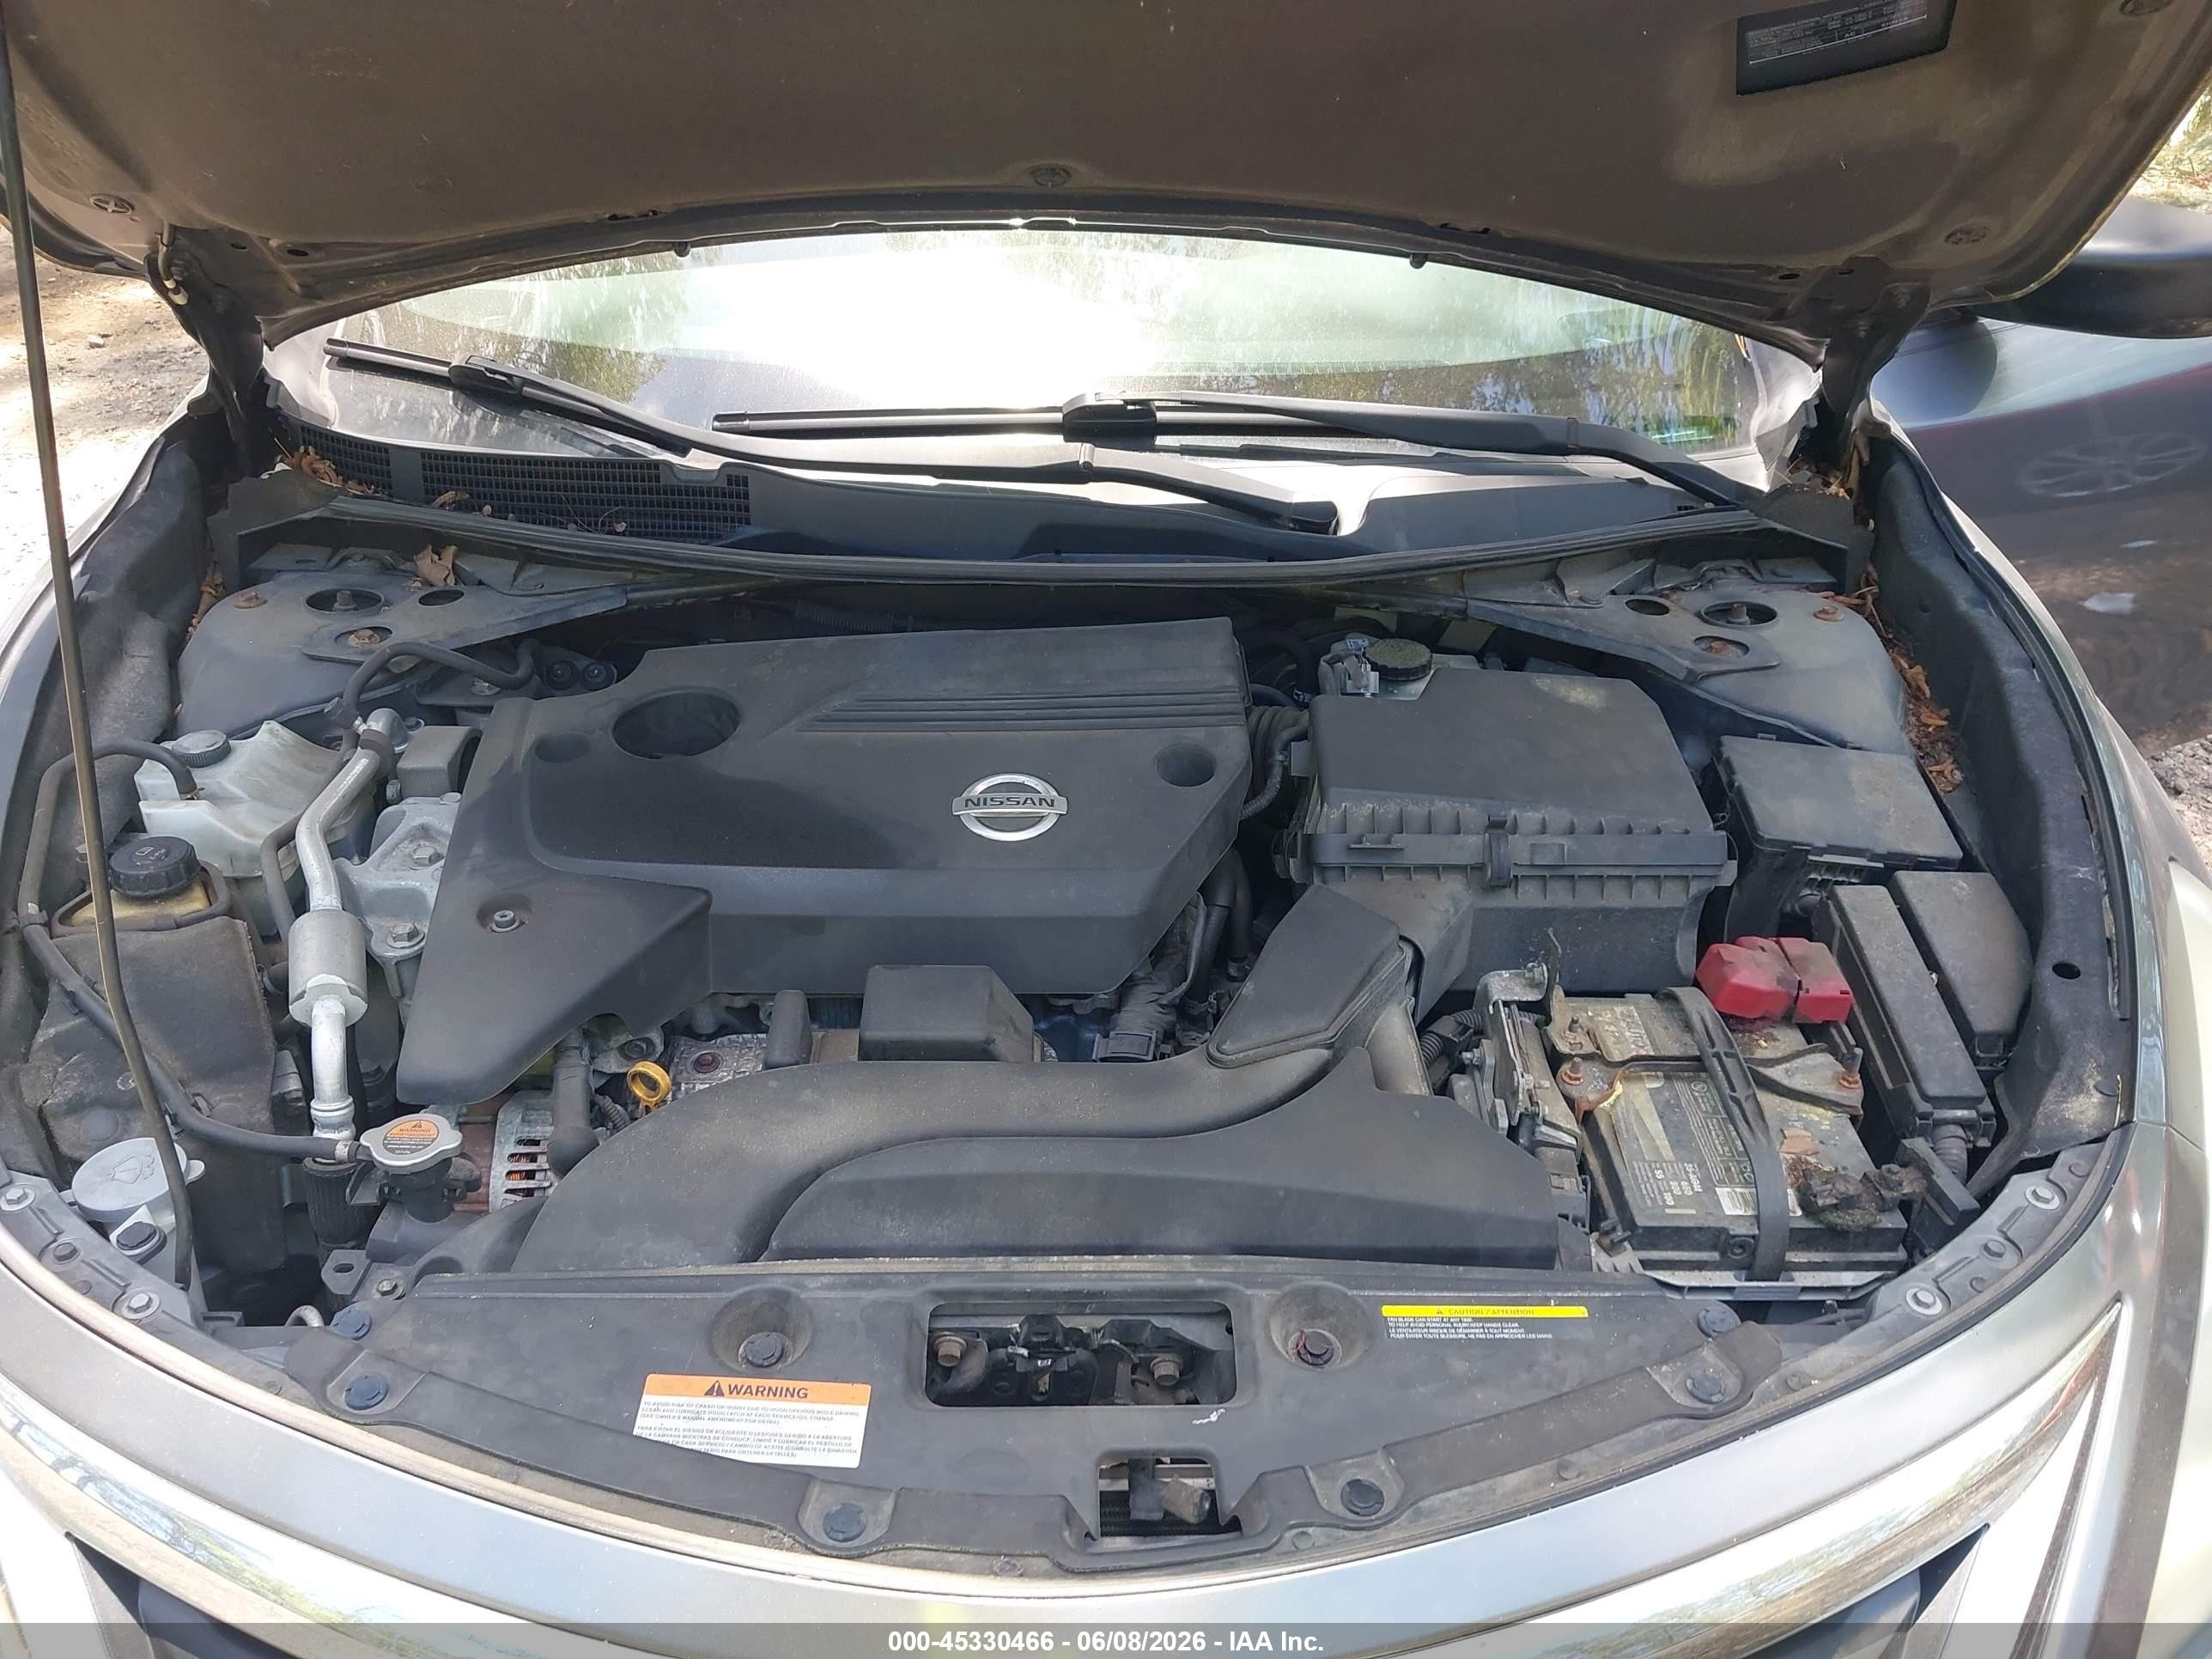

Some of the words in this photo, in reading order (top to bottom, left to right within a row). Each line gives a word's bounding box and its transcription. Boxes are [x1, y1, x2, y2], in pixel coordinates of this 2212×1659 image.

[964, 796, 1054, 808] NISSAN
[1654, 1169, 1665, 1179] 55
[1662, 1192, 1674, 1206] 100
[727, 1384, 808, 1399] WARNING
